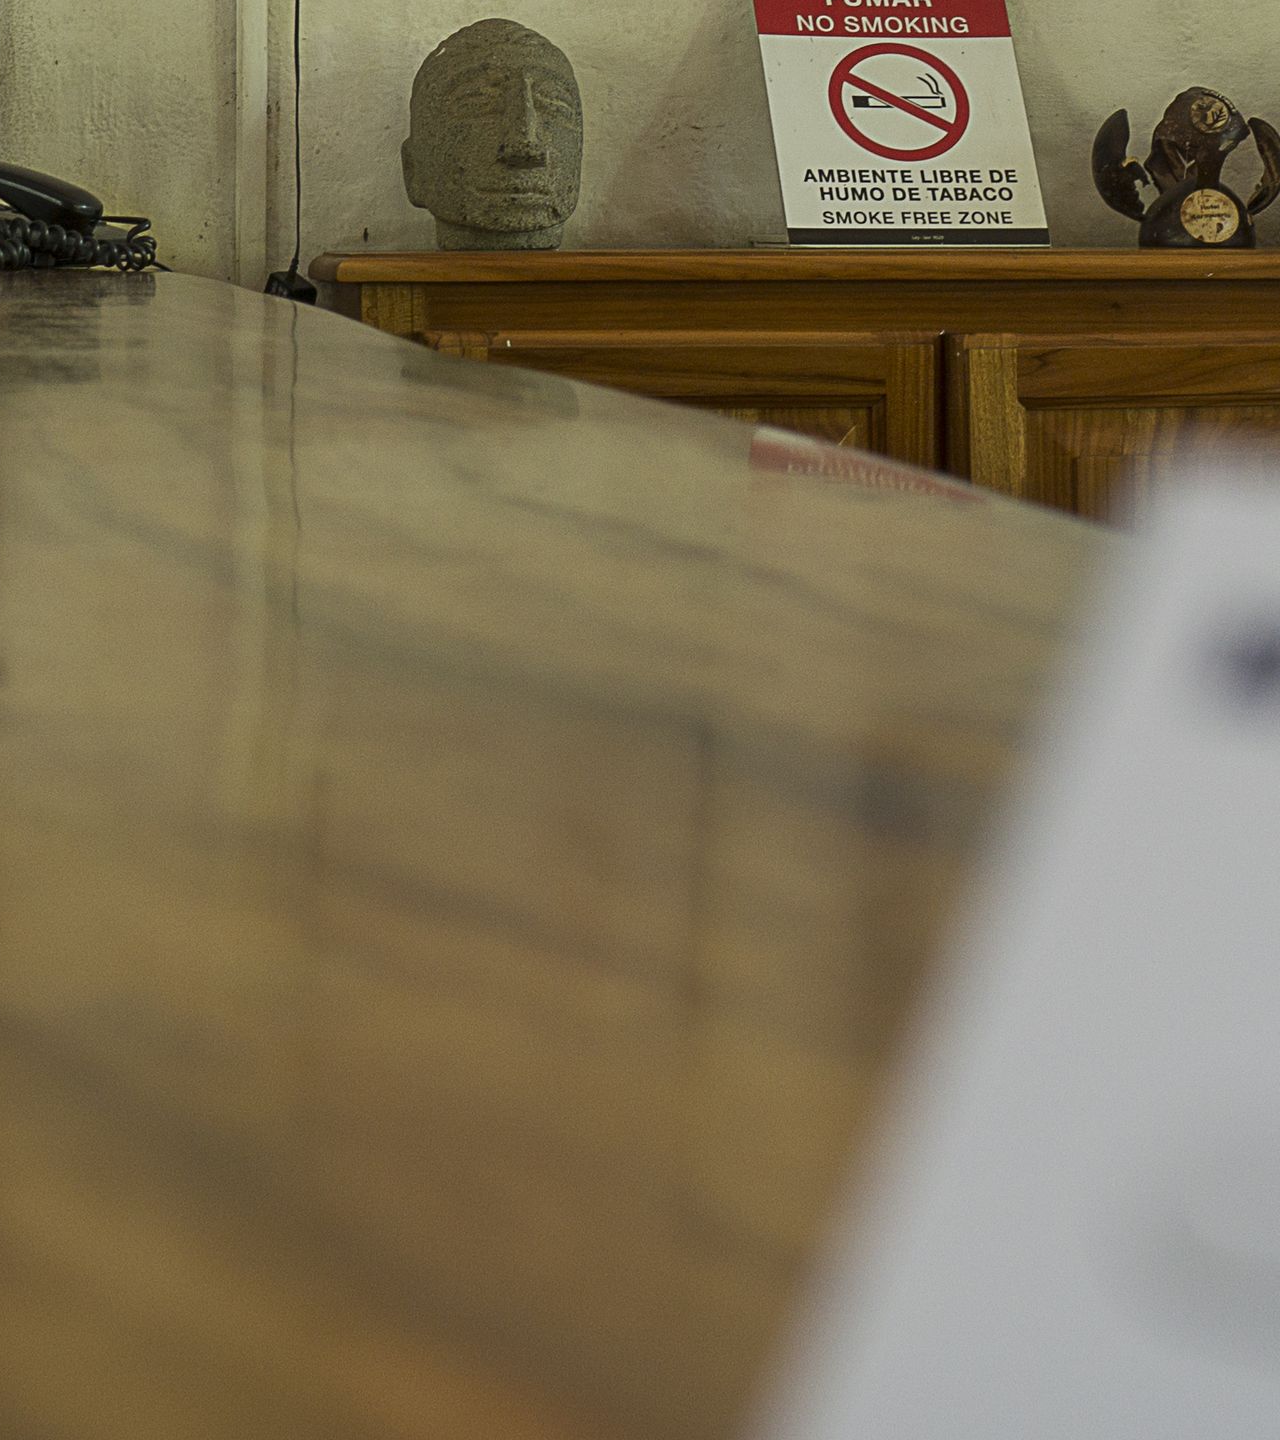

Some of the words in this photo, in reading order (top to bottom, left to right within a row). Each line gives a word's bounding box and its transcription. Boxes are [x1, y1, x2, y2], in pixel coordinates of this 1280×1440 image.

[797, 15, 834, 32] NO
[844, 16, 969, 33] SMOKING
[804, 169, 913, 183] AMBIENTE
[920, 170, 983, 183] LIBRE
[989, 170, 1018, 183] DE
[820, 187, 884, 201] HUMO
[892, 188, 921, 201] DE
[927, 187, 1013, 201] TABACO
[823, 211, 895, 224] SMOKE
[901, 212, 952, 224] FREE
[958, 212, 1013, 224] ZONE
